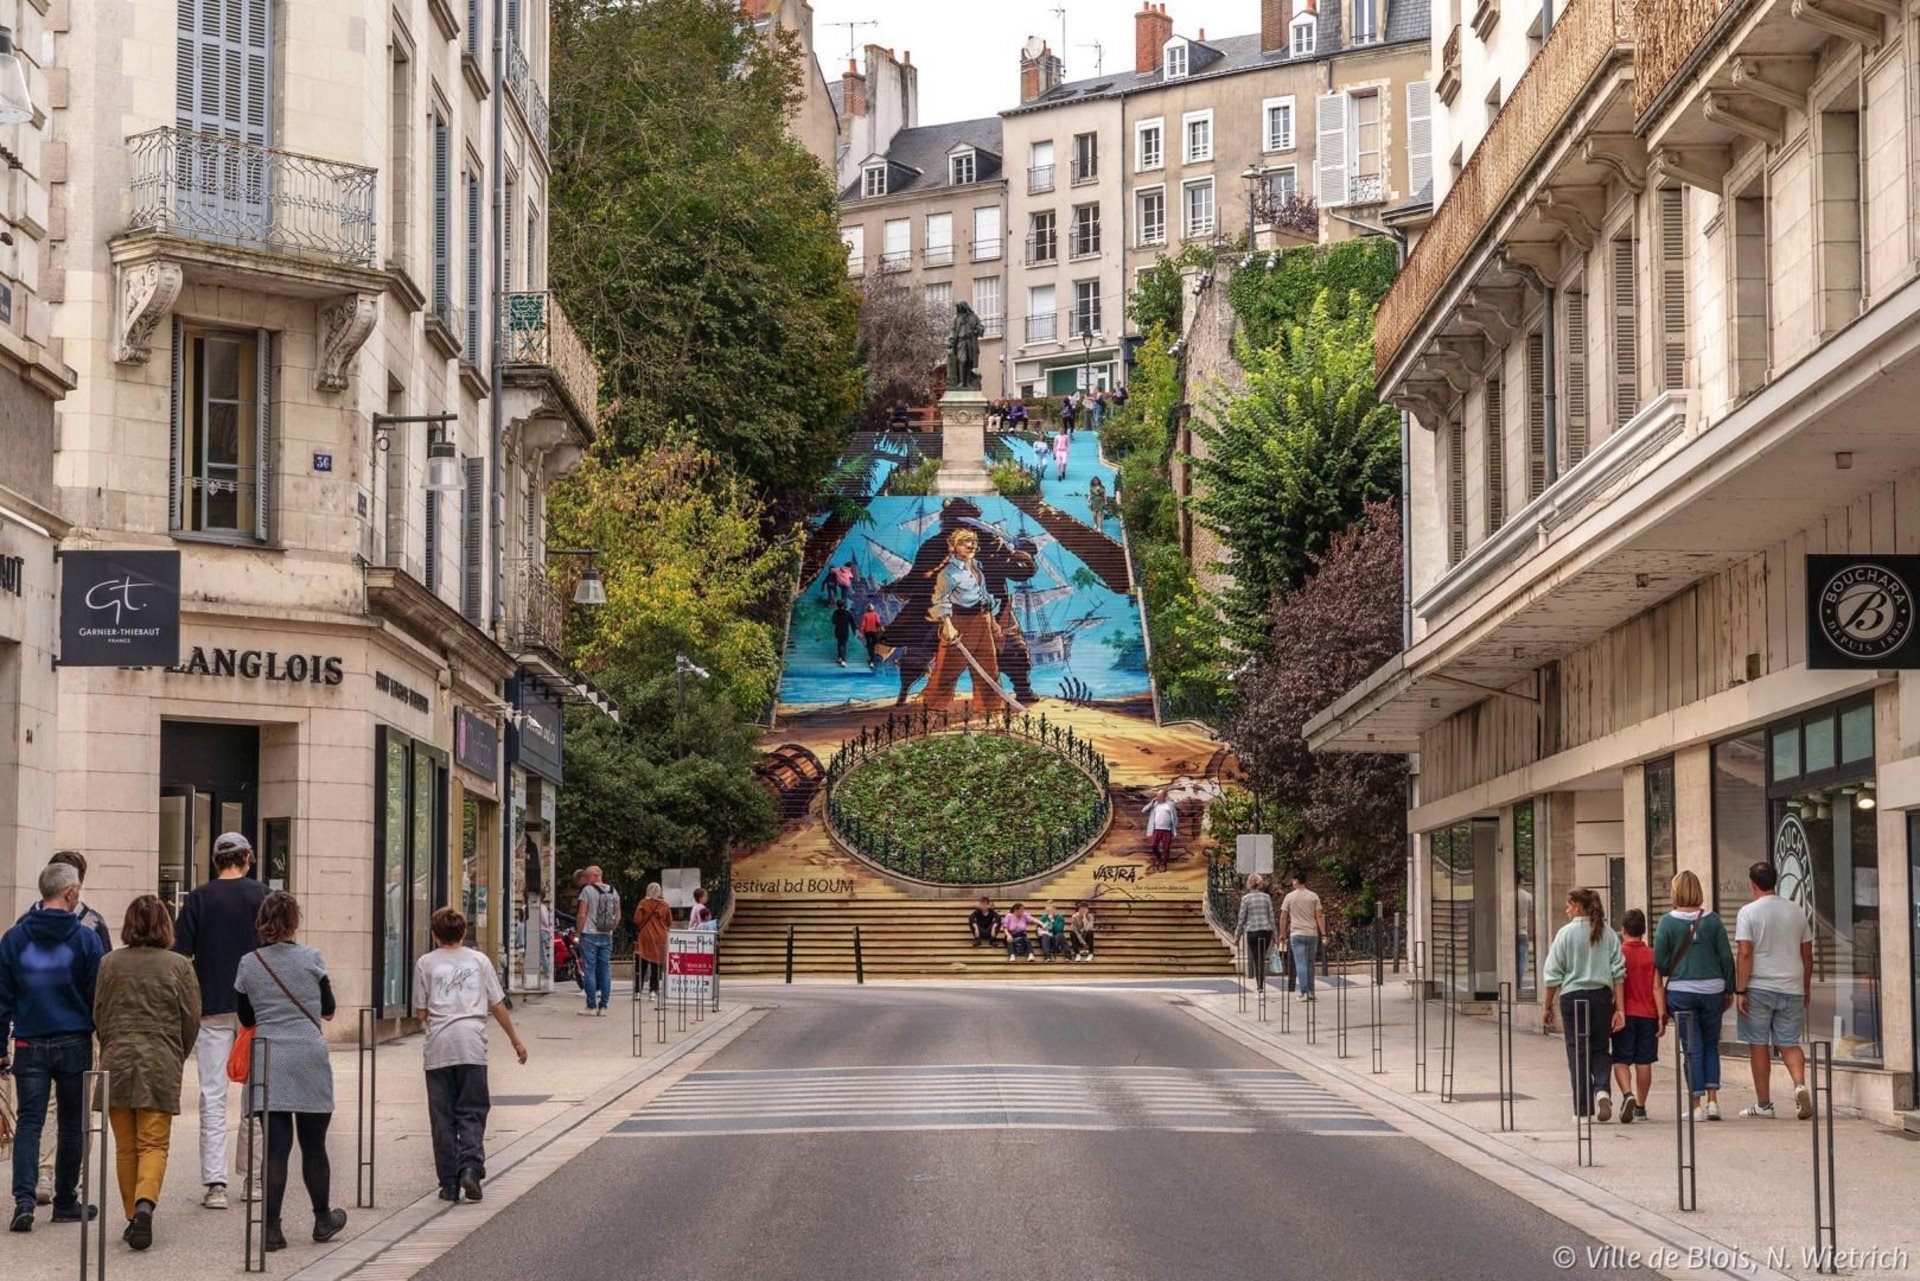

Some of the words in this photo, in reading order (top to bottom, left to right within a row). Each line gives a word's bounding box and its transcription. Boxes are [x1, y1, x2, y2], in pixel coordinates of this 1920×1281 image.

[1825, 569, 1906, 605] BOUCHARA
[79, 627, 160, 637] GARNIER-THIEBAUT
[1827, 620, 1873, 652] DEPUIS
[733, 879, 780, 893] estival
[784, 879, 804, 893] bd
[807, 879, 854, 893] BOUM
